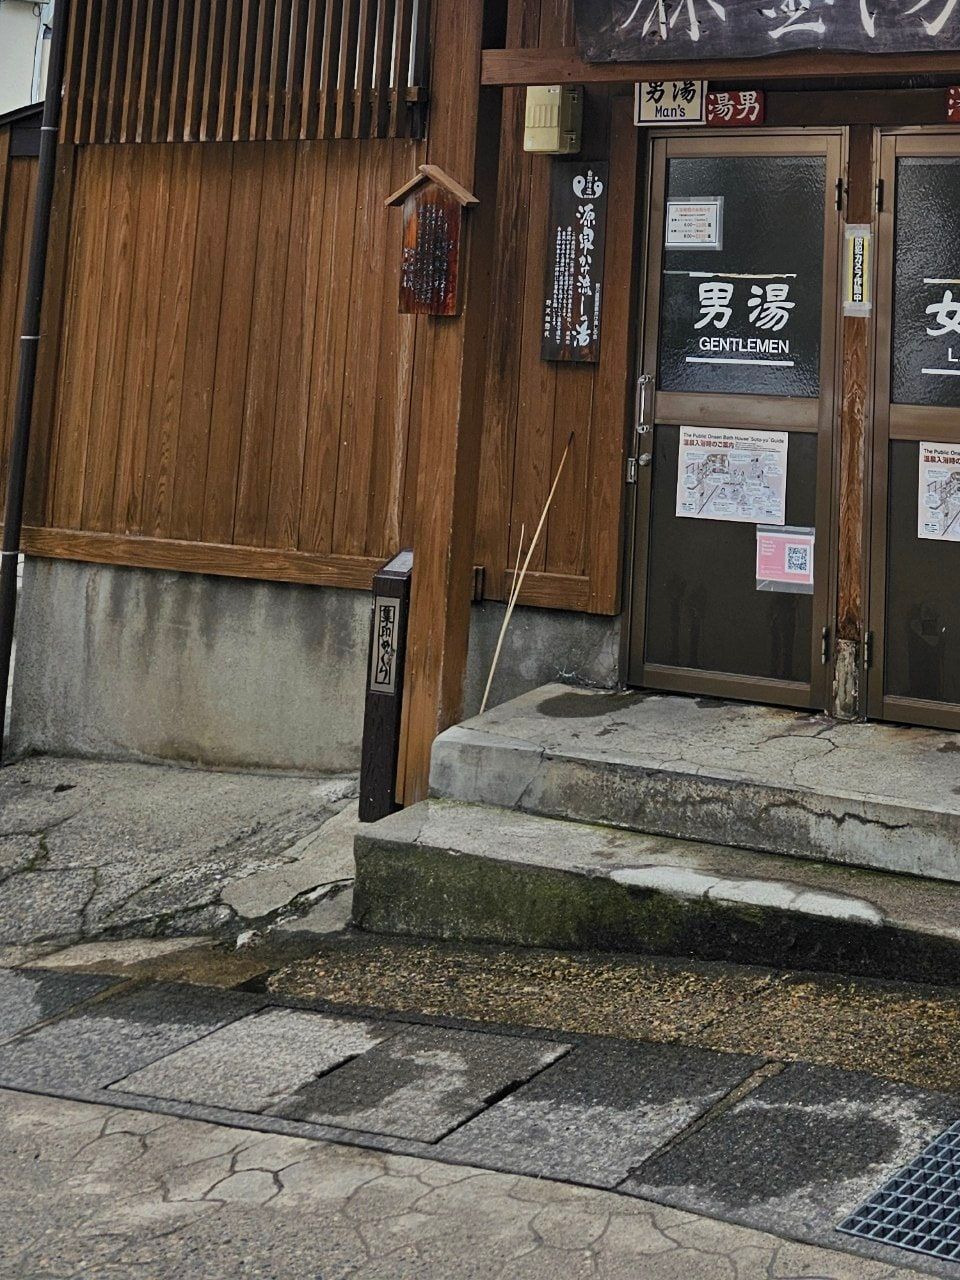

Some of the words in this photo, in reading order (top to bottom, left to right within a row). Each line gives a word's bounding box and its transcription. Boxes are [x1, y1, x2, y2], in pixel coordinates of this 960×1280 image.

[655, 104, 686, 118] Man's
[694, 282, 796, 332] 男湯
[699, 337, 790, 354] GENTLEMEN
